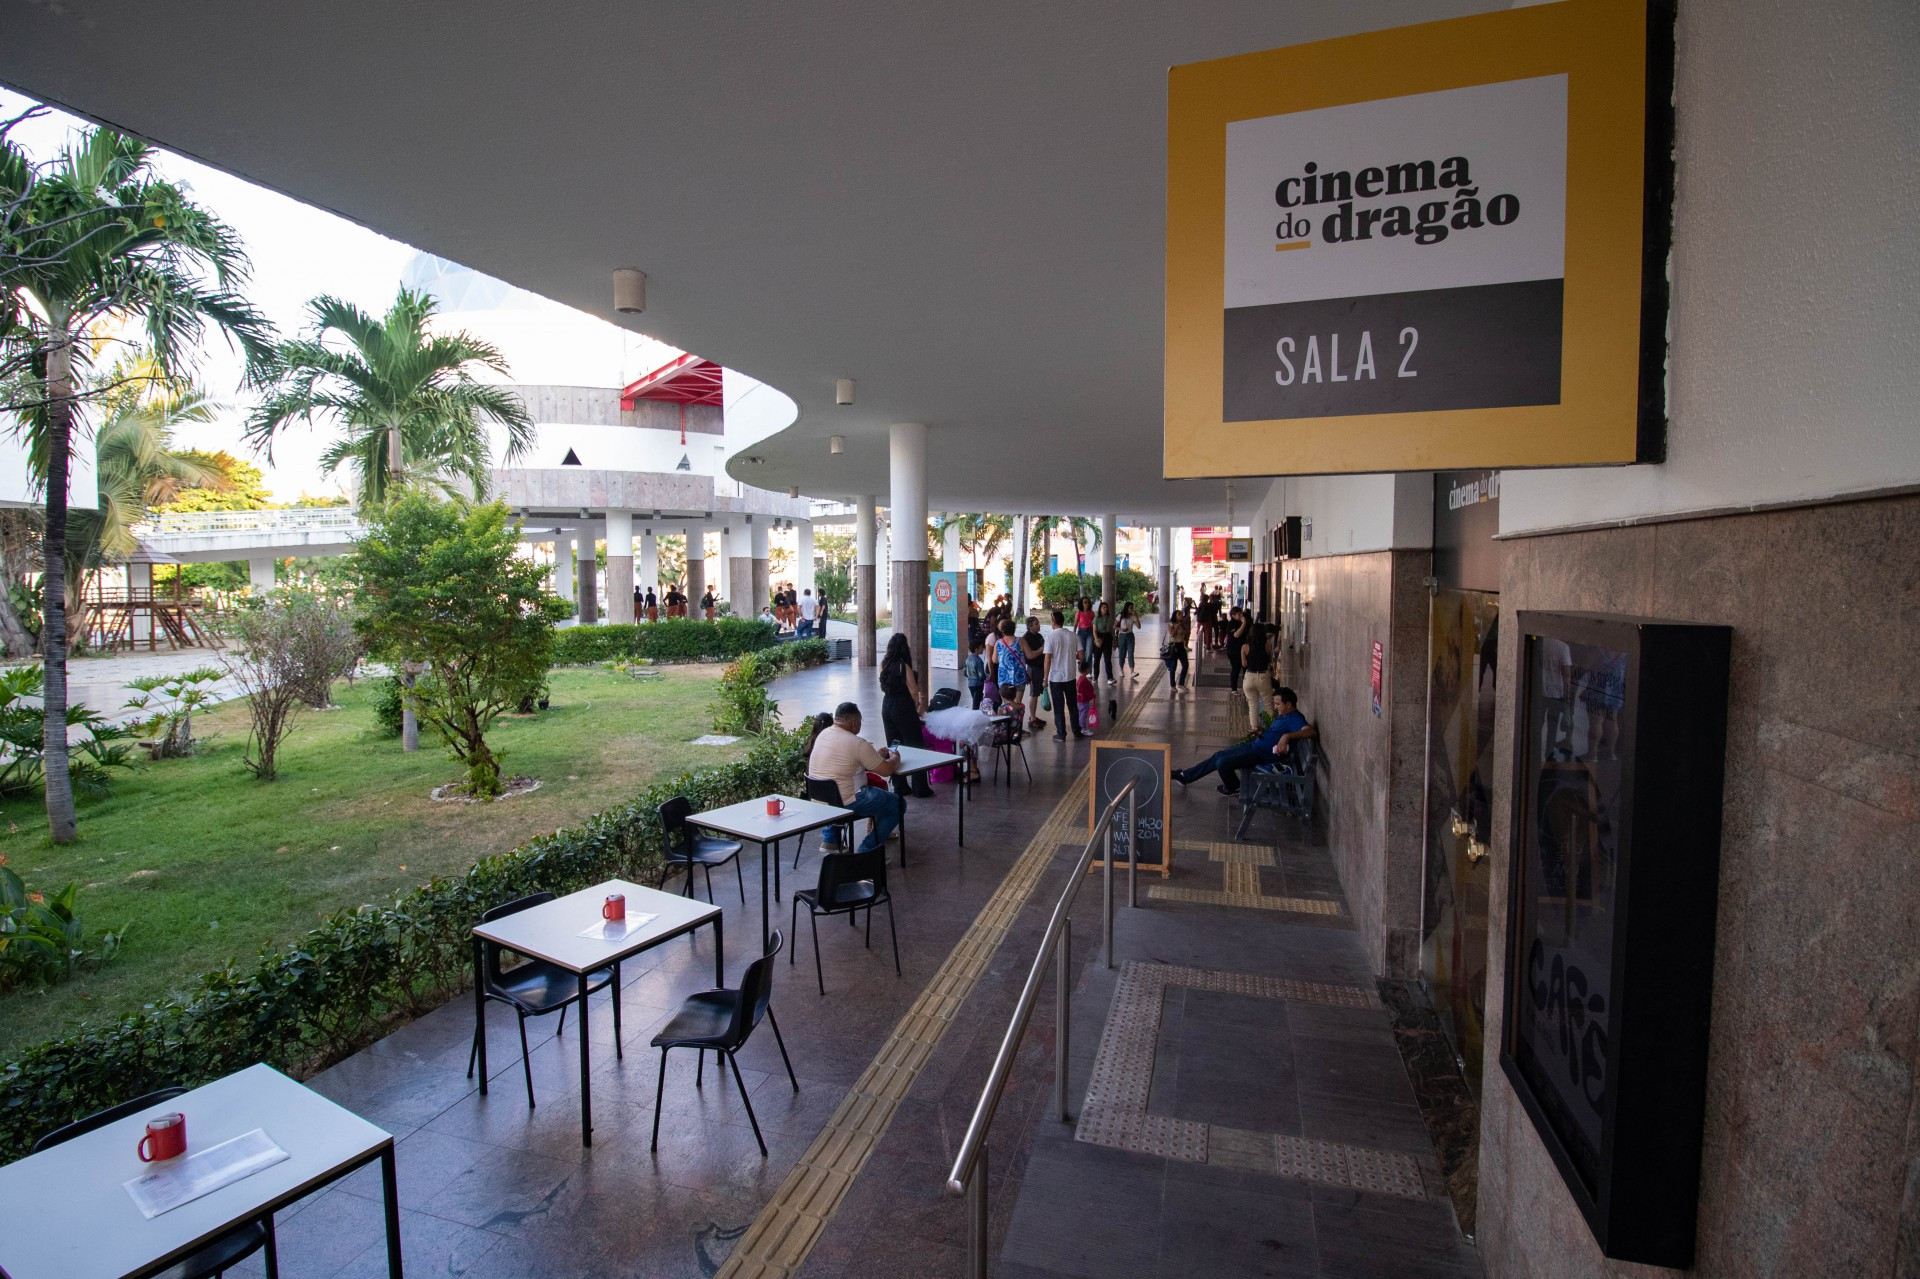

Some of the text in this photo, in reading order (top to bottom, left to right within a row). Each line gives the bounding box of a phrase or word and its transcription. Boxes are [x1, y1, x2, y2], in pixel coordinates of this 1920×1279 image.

[1275, 156, 1473, 208] cinema
[1275, 186, 1521, 246] do dragão
[1275, 326, 1419, 387] SALA 2
[1448, 479, 1480, 511] cinema
[1480, 472, 1488, 494] do
[1137, 830, 1160, 841] 20h
